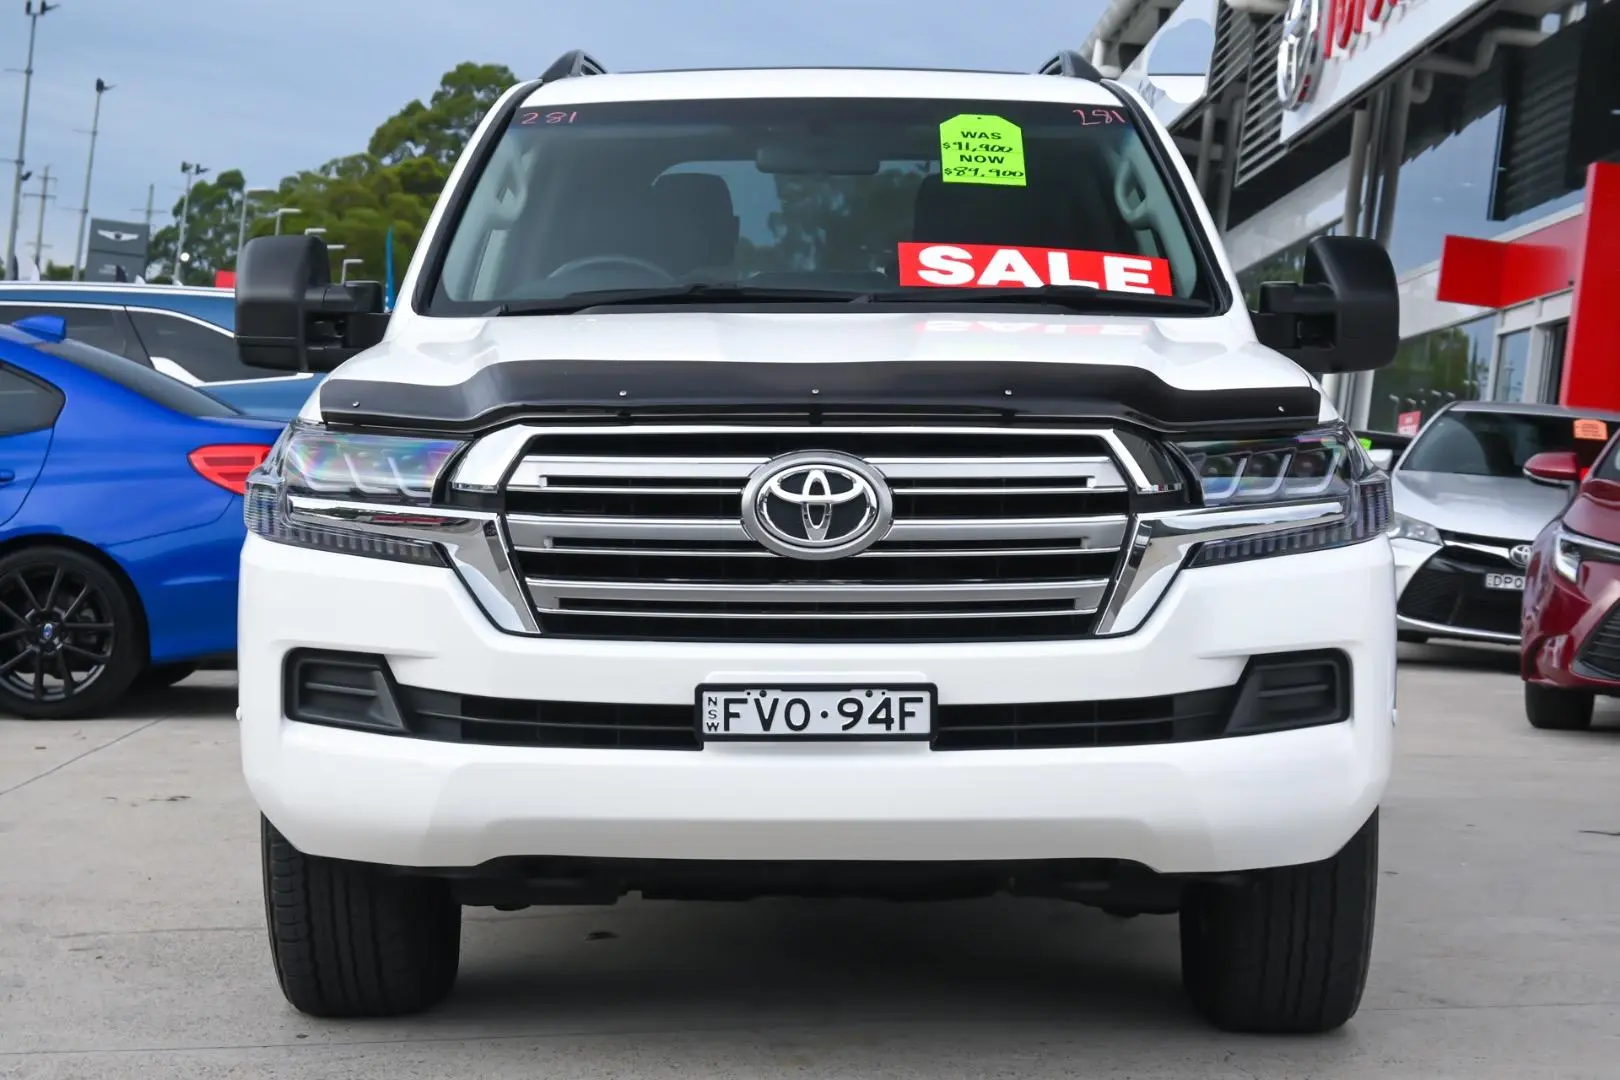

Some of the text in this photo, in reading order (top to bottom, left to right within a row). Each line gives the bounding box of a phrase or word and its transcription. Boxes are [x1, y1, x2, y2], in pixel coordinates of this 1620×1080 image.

[521, 111, 577, 125] 281
[1072, 109, 1126, 126] 281
[961, 131, 1002, 140] WAS
[960, 154, 1005, 164] NOW
[918, 245, 1155, 294] SALE
